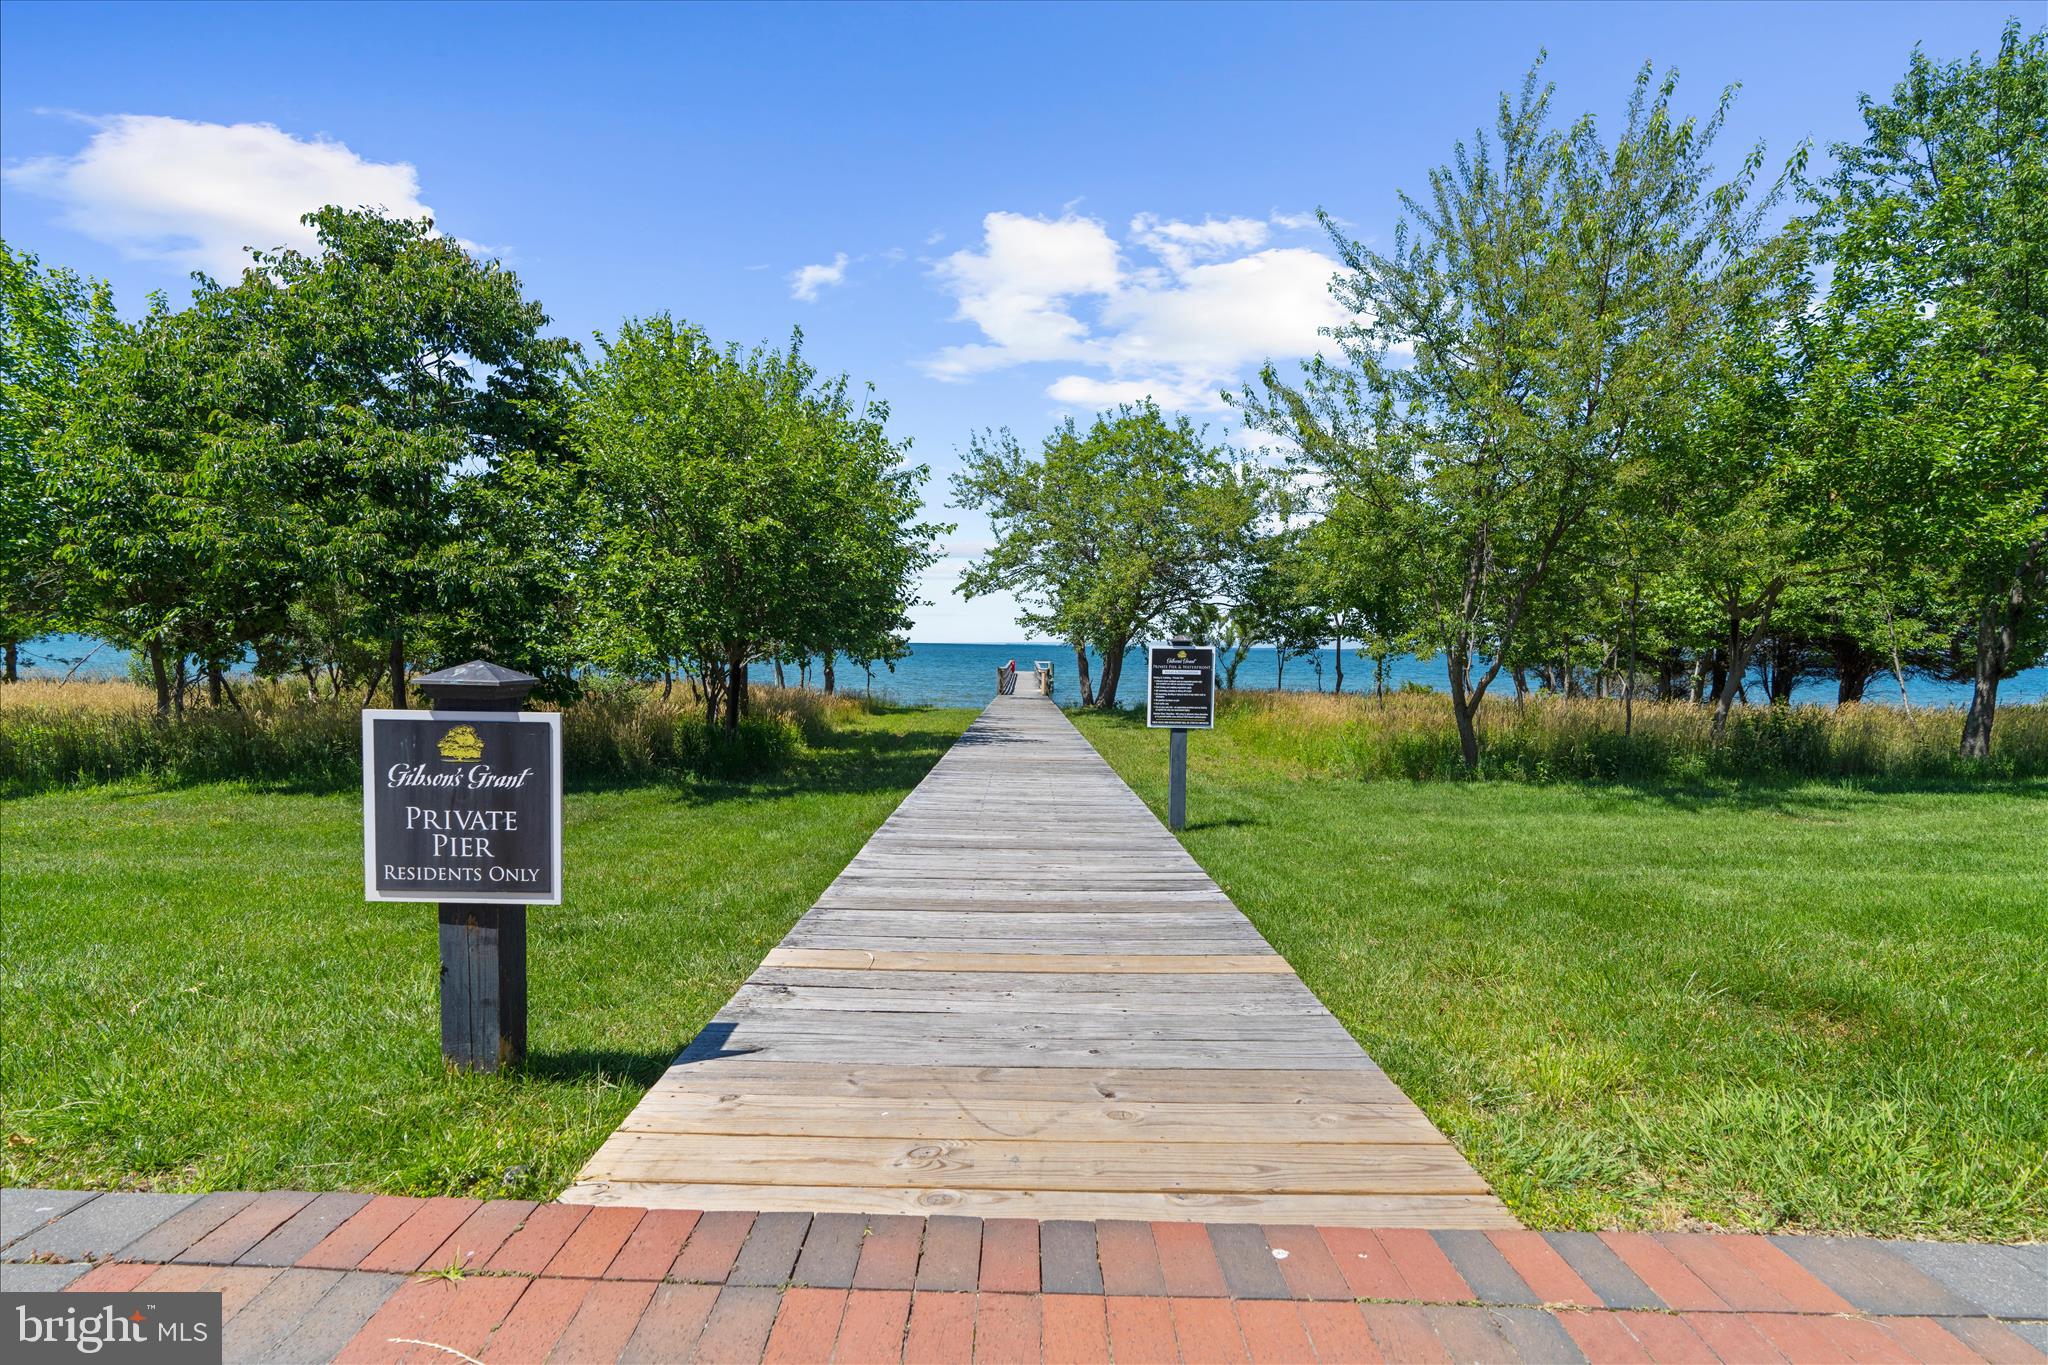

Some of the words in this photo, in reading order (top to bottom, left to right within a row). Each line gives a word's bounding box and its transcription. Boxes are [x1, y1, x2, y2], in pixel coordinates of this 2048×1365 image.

[387, 763, 464, 788] Gibson's
[467, 764, 534, 790] Grant
[405, 806, 518, 831] PRIVATE
[432, 833, 495, 858] PIER
[384, 865, 482, 882] RESIDENTS
[489, 866, 541, 882] ONLY
